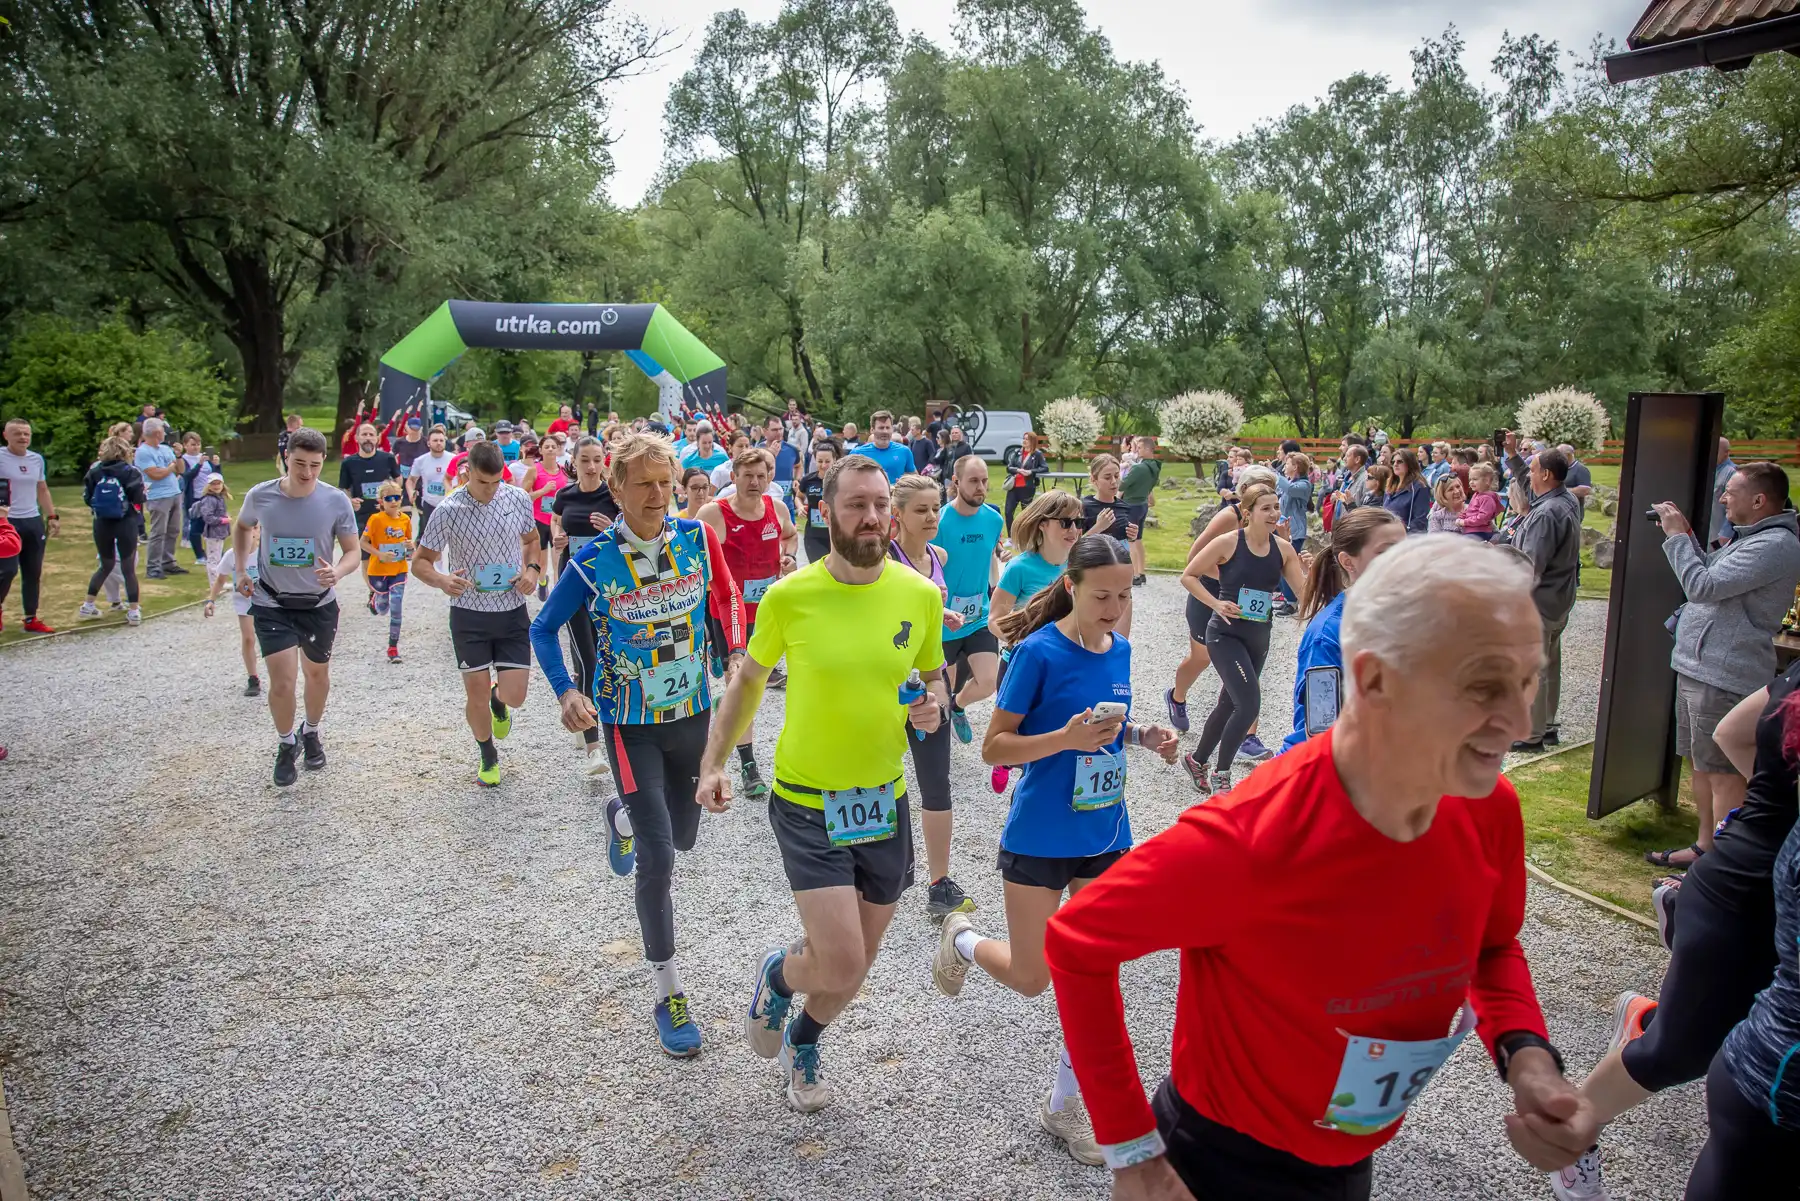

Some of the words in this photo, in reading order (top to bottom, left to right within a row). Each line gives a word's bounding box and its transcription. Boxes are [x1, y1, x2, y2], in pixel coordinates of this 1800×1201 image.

[496, 314, 601, 335] utrka.com
[277, 546, 306, 559] 132
[492, 573, 502, 585] 2
[608, 567, 704, 612] TRI-SPORT
[626, 607, 658, 621] Bikes
[661, 603, 668, 614] &
[668, 593, 699, 612] Kayaks
[962, 603, 976, 615] 49
[1249, 599, 1265, 613] 82
[663, 671, 690, 697] 24
[1089, 766, 1122, 793] 185
[837, 800, 884, 828] 104
